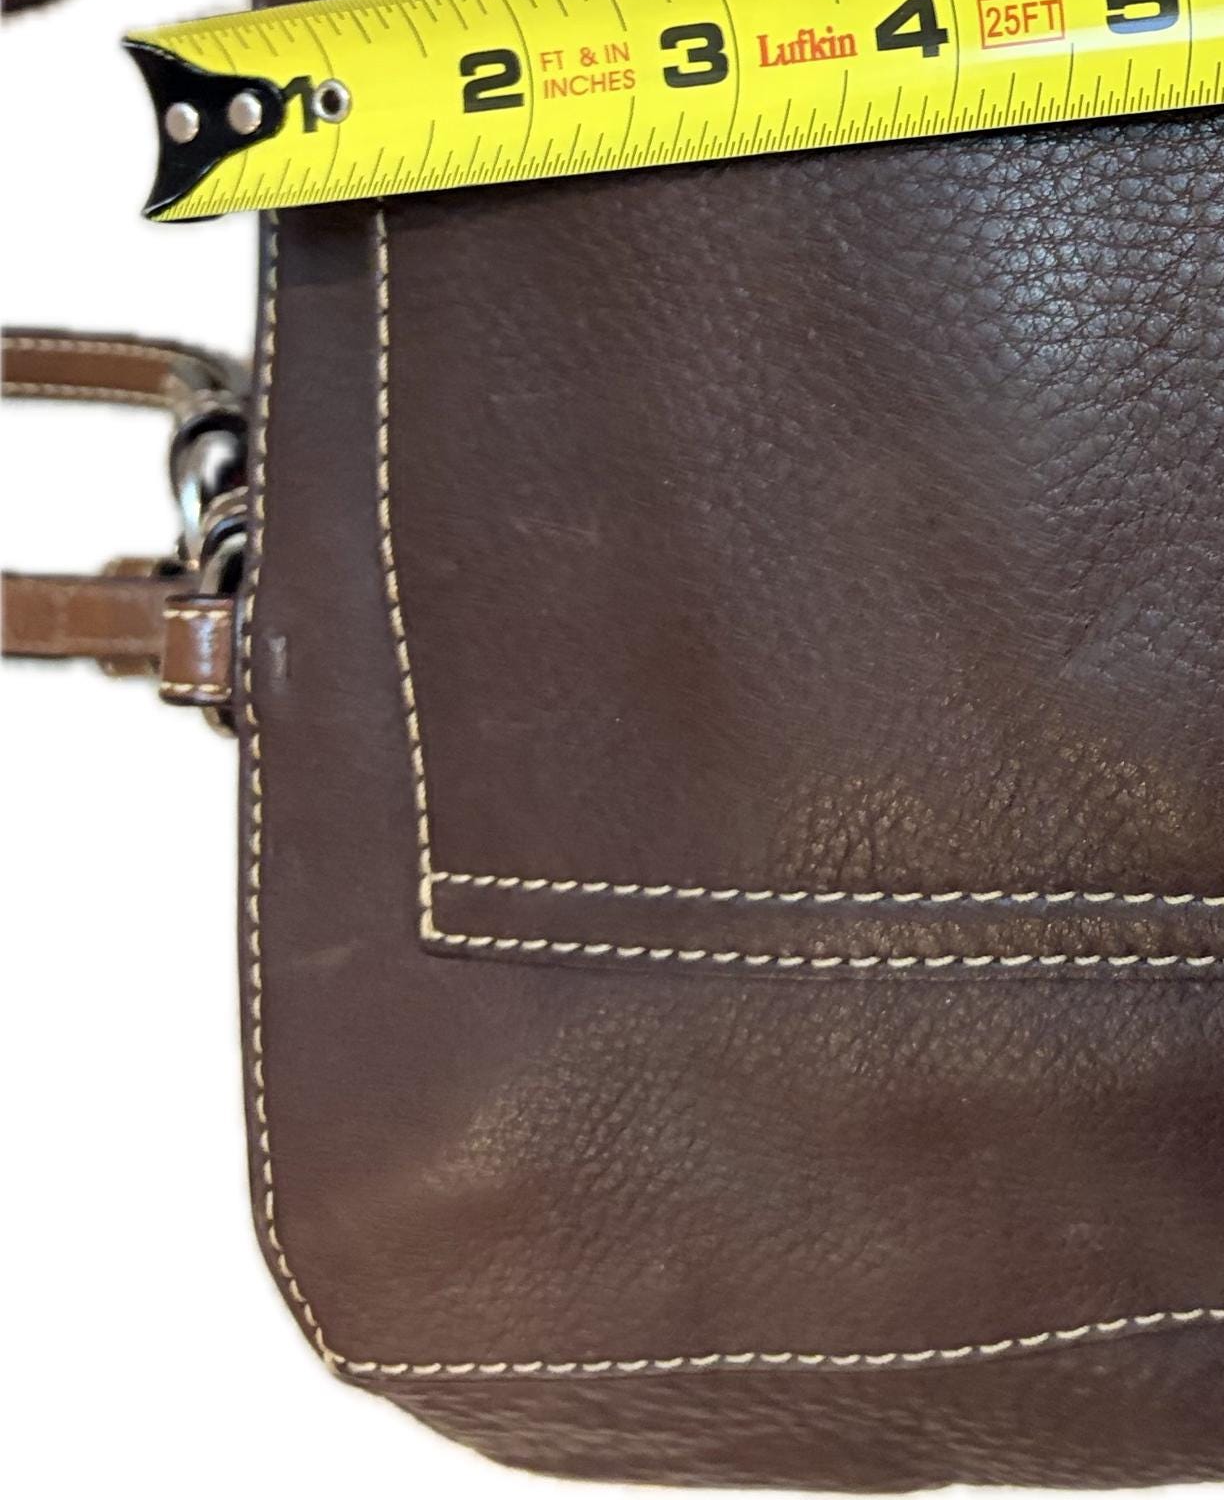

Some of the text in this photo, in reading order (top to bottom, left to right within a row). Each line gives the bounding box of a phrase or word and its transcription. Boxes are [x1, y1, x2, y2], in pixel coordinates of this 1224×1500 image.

[540, 42, 631, 72] FT & IN
[660, 22, 729, 88] 3
[757, 25, 858, 68] Lufkin
[459, 48, 525, 113] 2
[543, 69, 636, 99] INCHES
